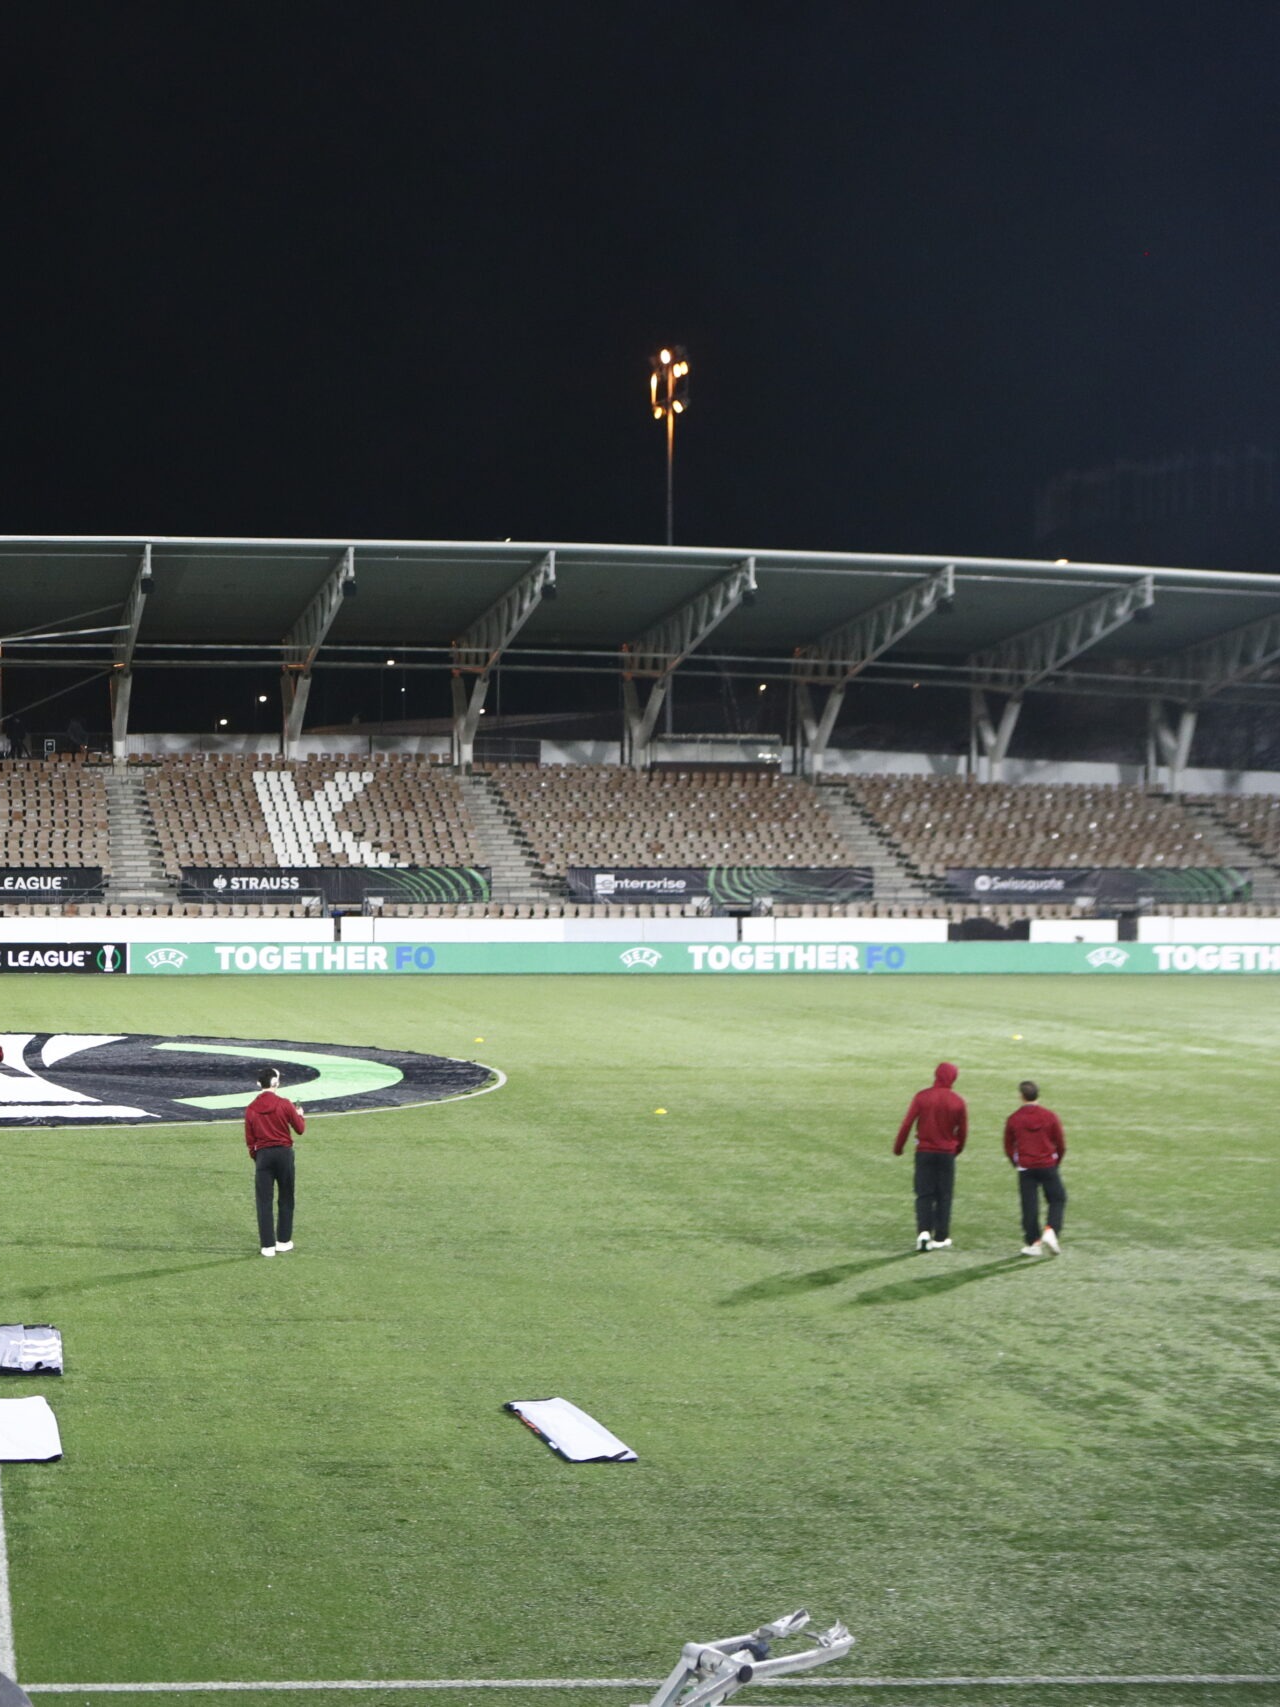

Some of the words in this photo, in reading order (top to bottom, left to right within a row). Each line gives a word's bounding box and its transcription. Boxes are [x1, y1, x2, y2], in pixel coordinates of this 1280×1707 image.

[230, 877, 299, 890] STRAUSS
[146, 949, 187, 968] UEFA
[214, 945, 388, 970] TOGETHER
[395, 945, 436, 970] FO
[621, 948, 661, 967] UEFA
[687, 945, 859, 970] TOGETHER
[866, 945, 905, 970] FO
